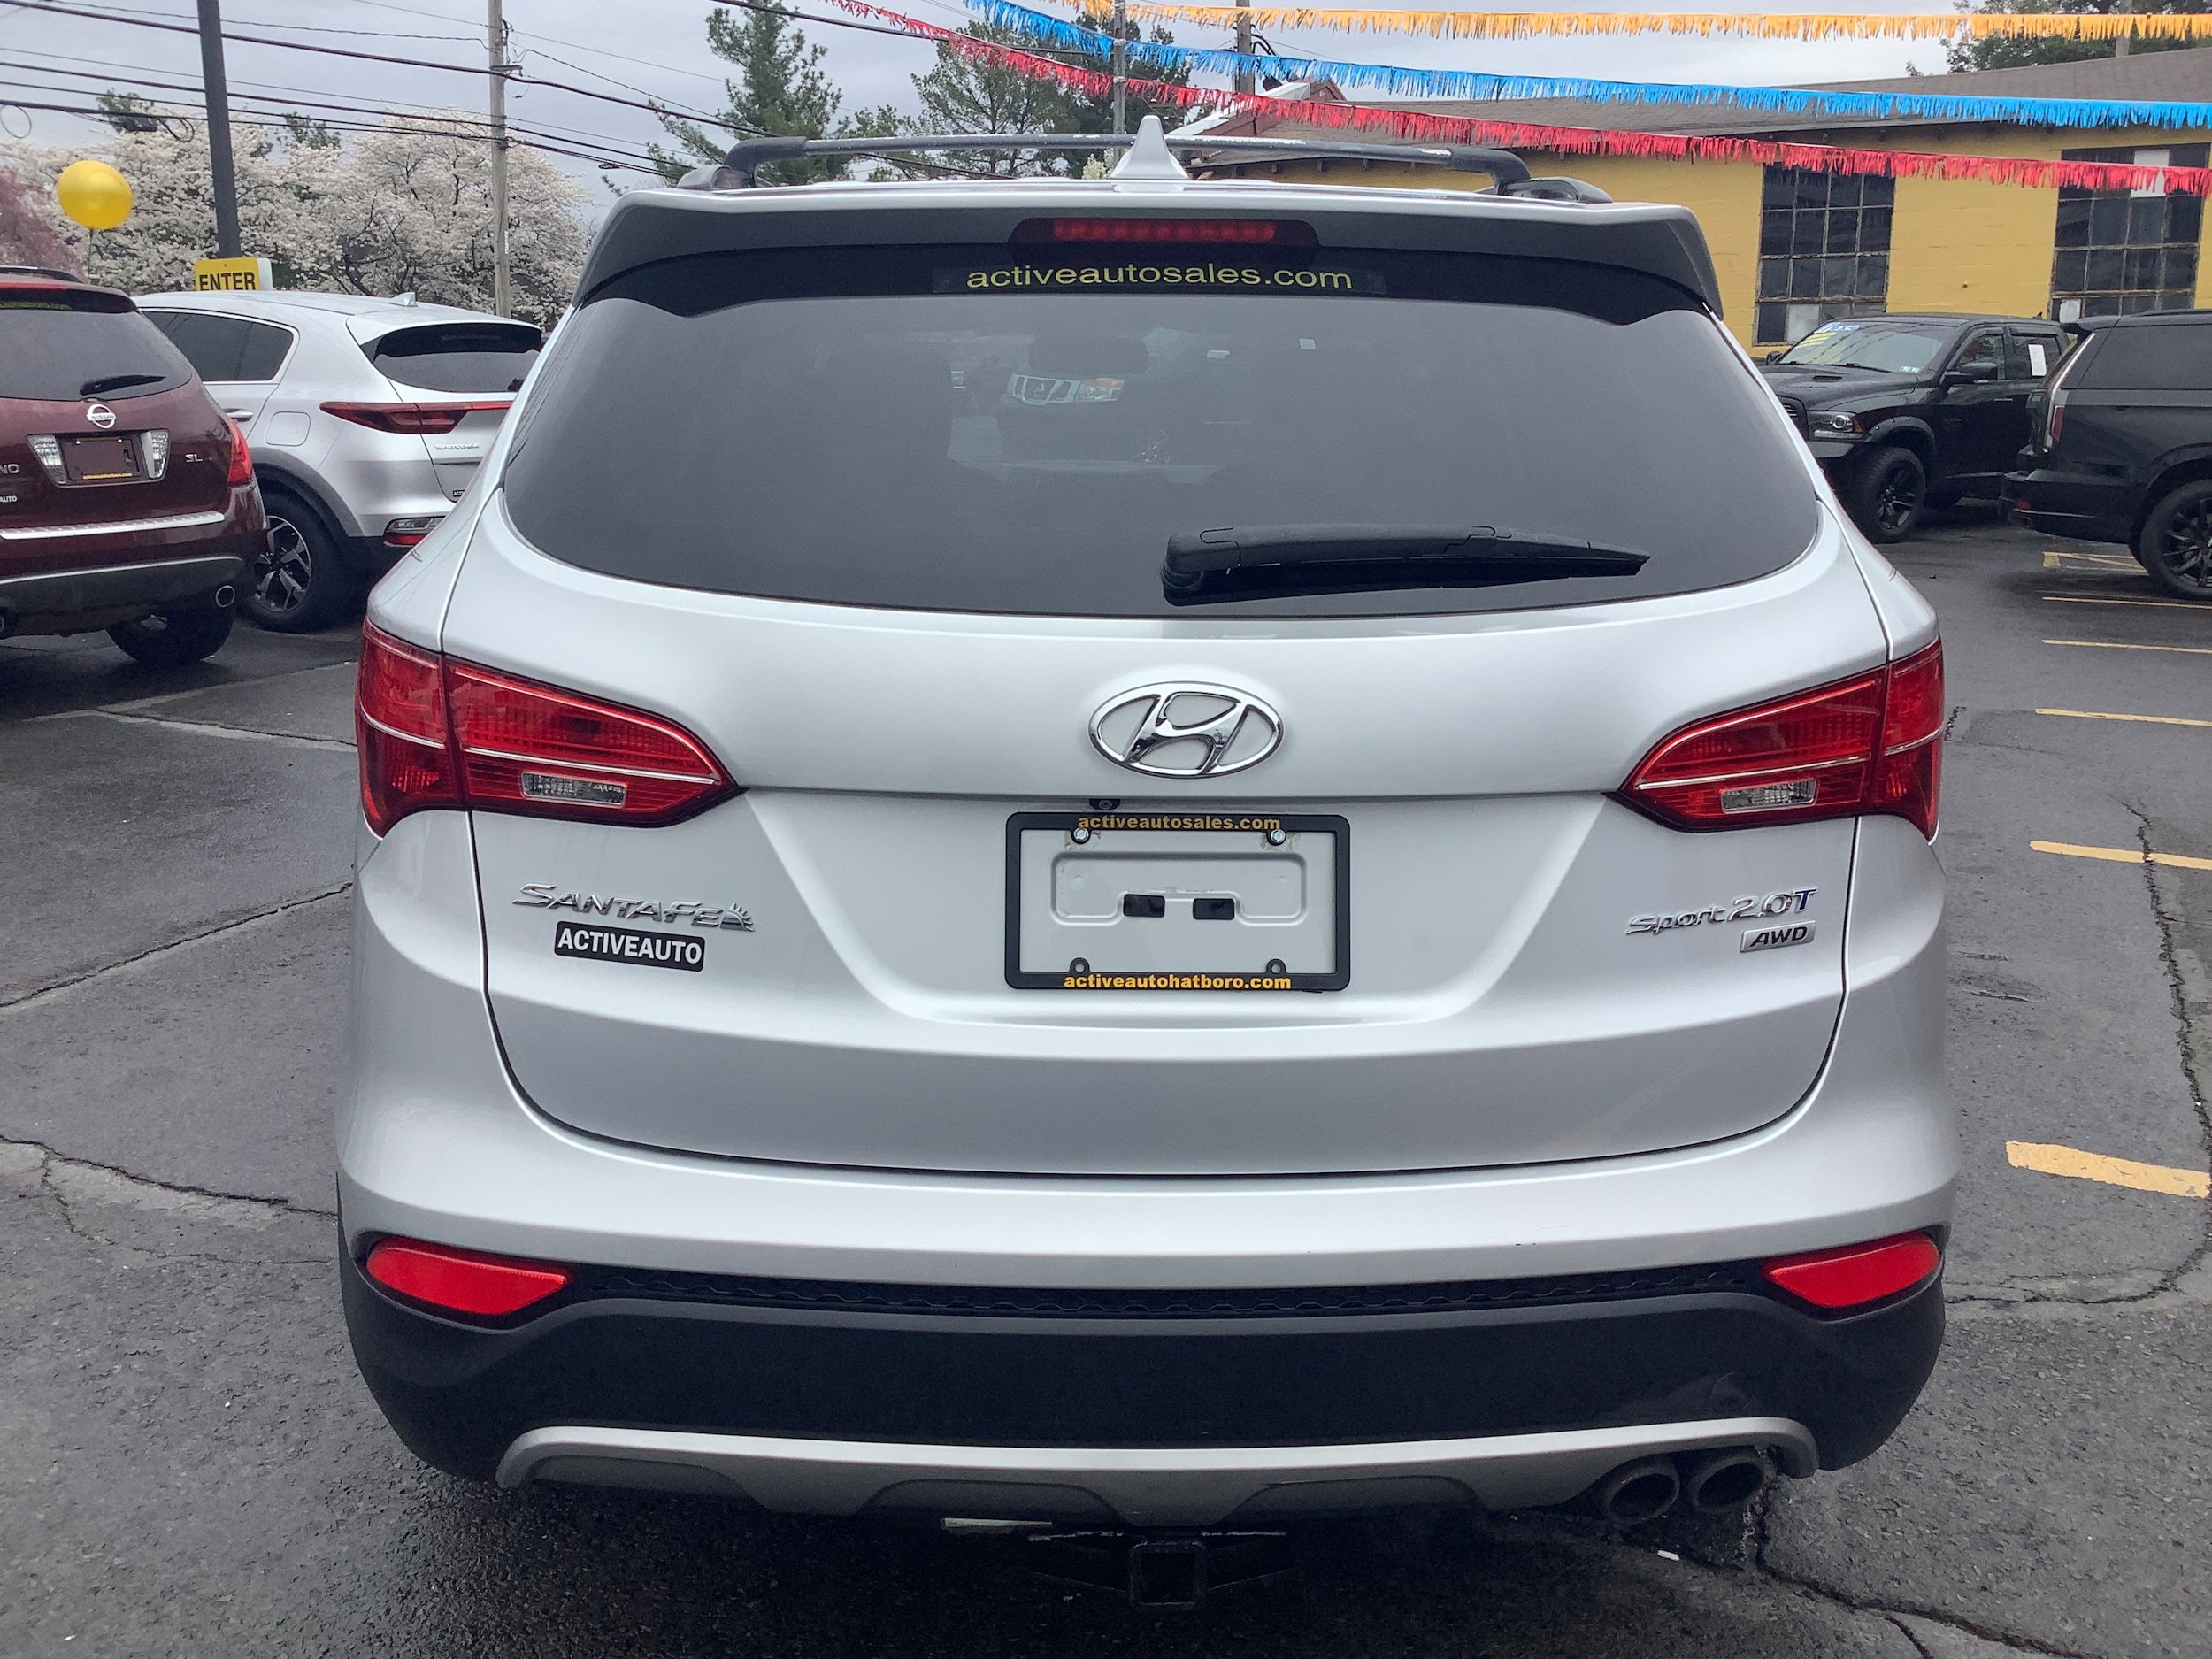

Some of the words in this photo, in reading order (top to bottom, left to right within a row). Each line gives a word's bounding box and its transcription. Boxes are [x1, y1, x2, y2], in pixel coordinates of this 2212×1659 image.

[199, 272, 256, 291] ENTER
[966, 263, 1354, 290] activeautosales.com
[186, 454, 204, 463] SL
[1078, 816, 1280, 830] activeautosales.com
[557, 927, 703, 964] ACTIVEAUTO
[1749, 926, 1809, 948] AWD
[1064, 973, 1292, 990] activeautohatboro.com
